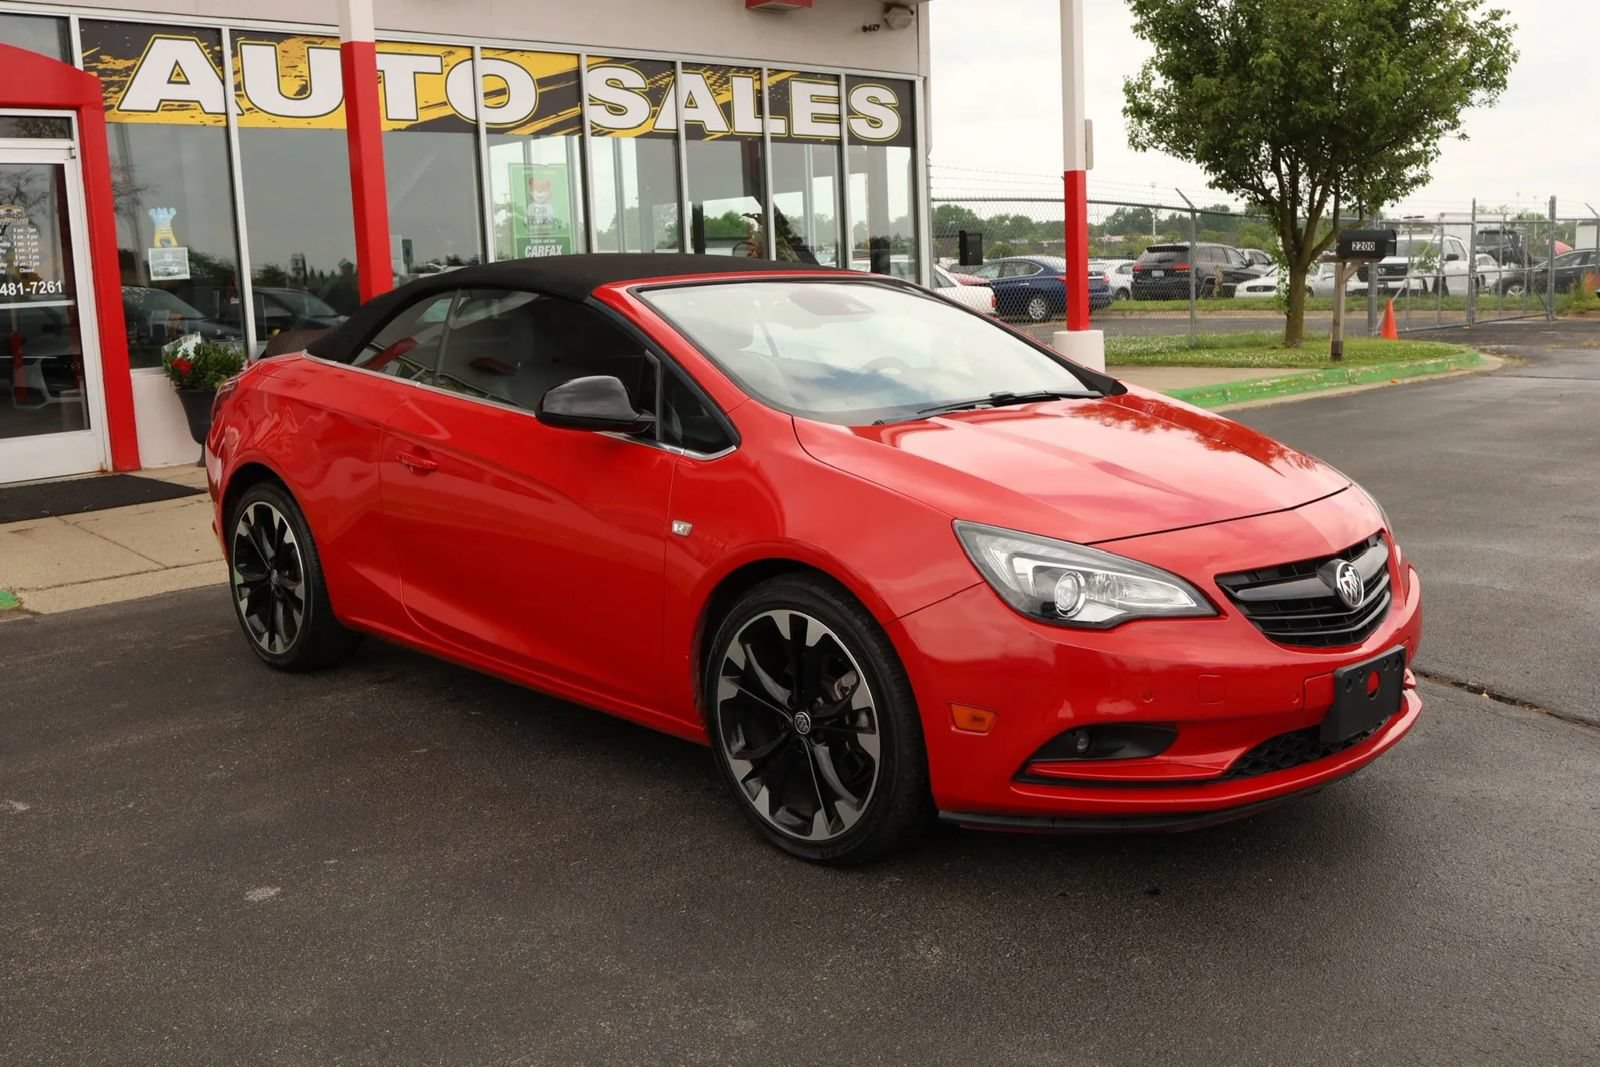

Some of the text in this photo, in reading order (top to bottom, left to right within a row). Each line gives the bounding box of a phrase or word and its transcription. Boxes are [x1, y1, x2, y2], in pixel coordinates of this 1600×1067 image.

[116, 35, 900, 141] AUTO SALES
[525, 245, 562, 257] CARFAX
[1352, 242, 1375, 250] 2200
